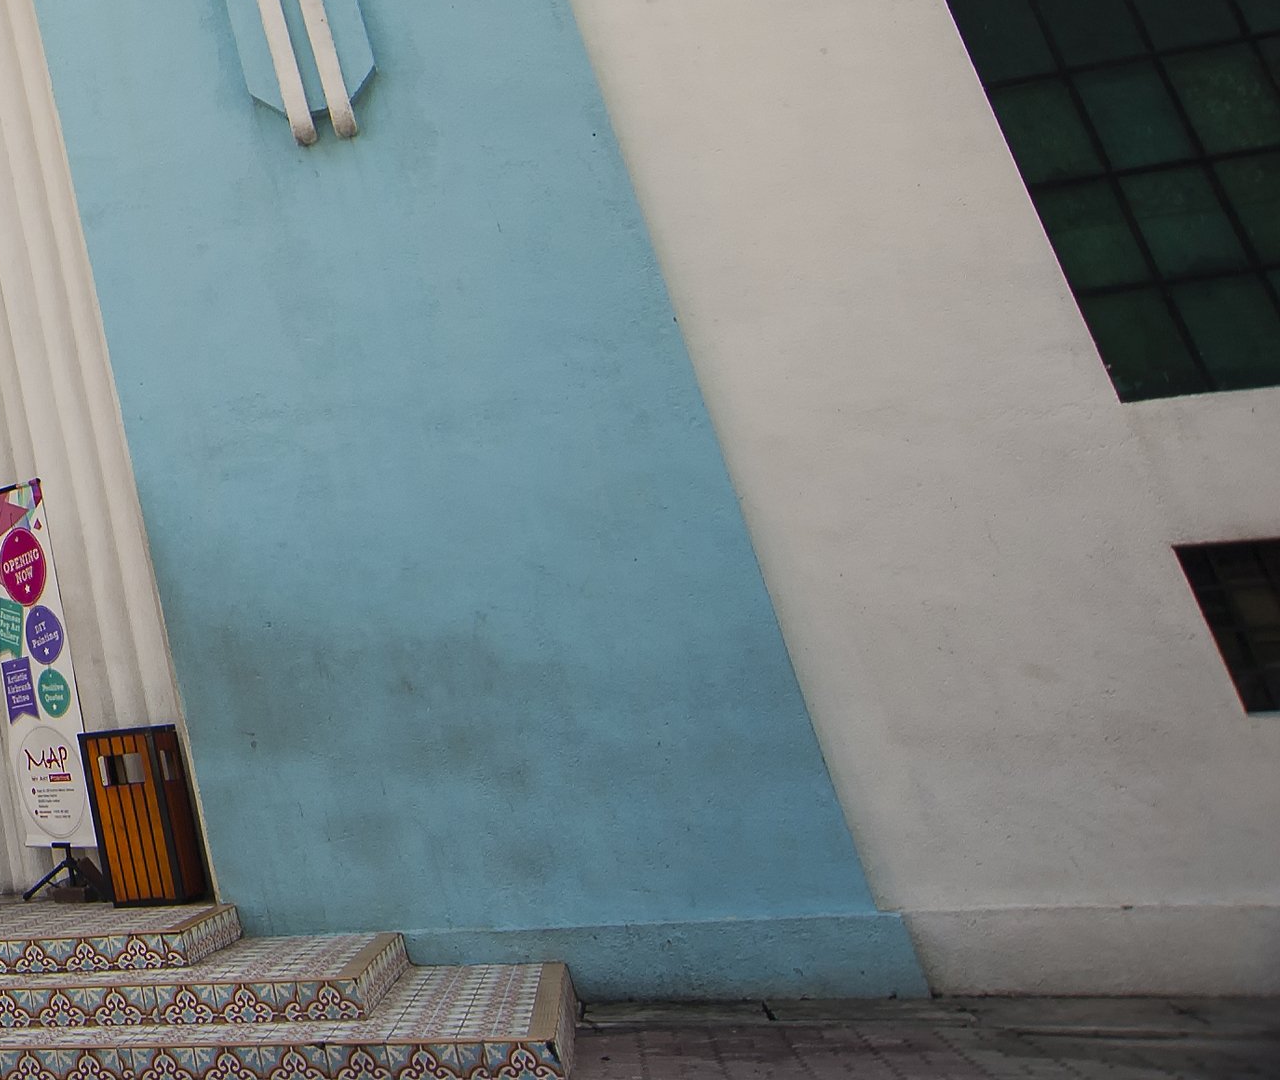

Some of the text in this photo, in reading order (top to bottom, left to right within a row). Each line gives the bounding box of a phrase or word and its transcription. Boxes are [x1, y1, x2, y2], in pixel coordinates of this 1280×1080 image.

[3, 548, 40, 574] OPENING
[15, 565, 33, 584] NOW
[32, 631, 60, 648] Painting
[24, 746, 67, 772] MAP
